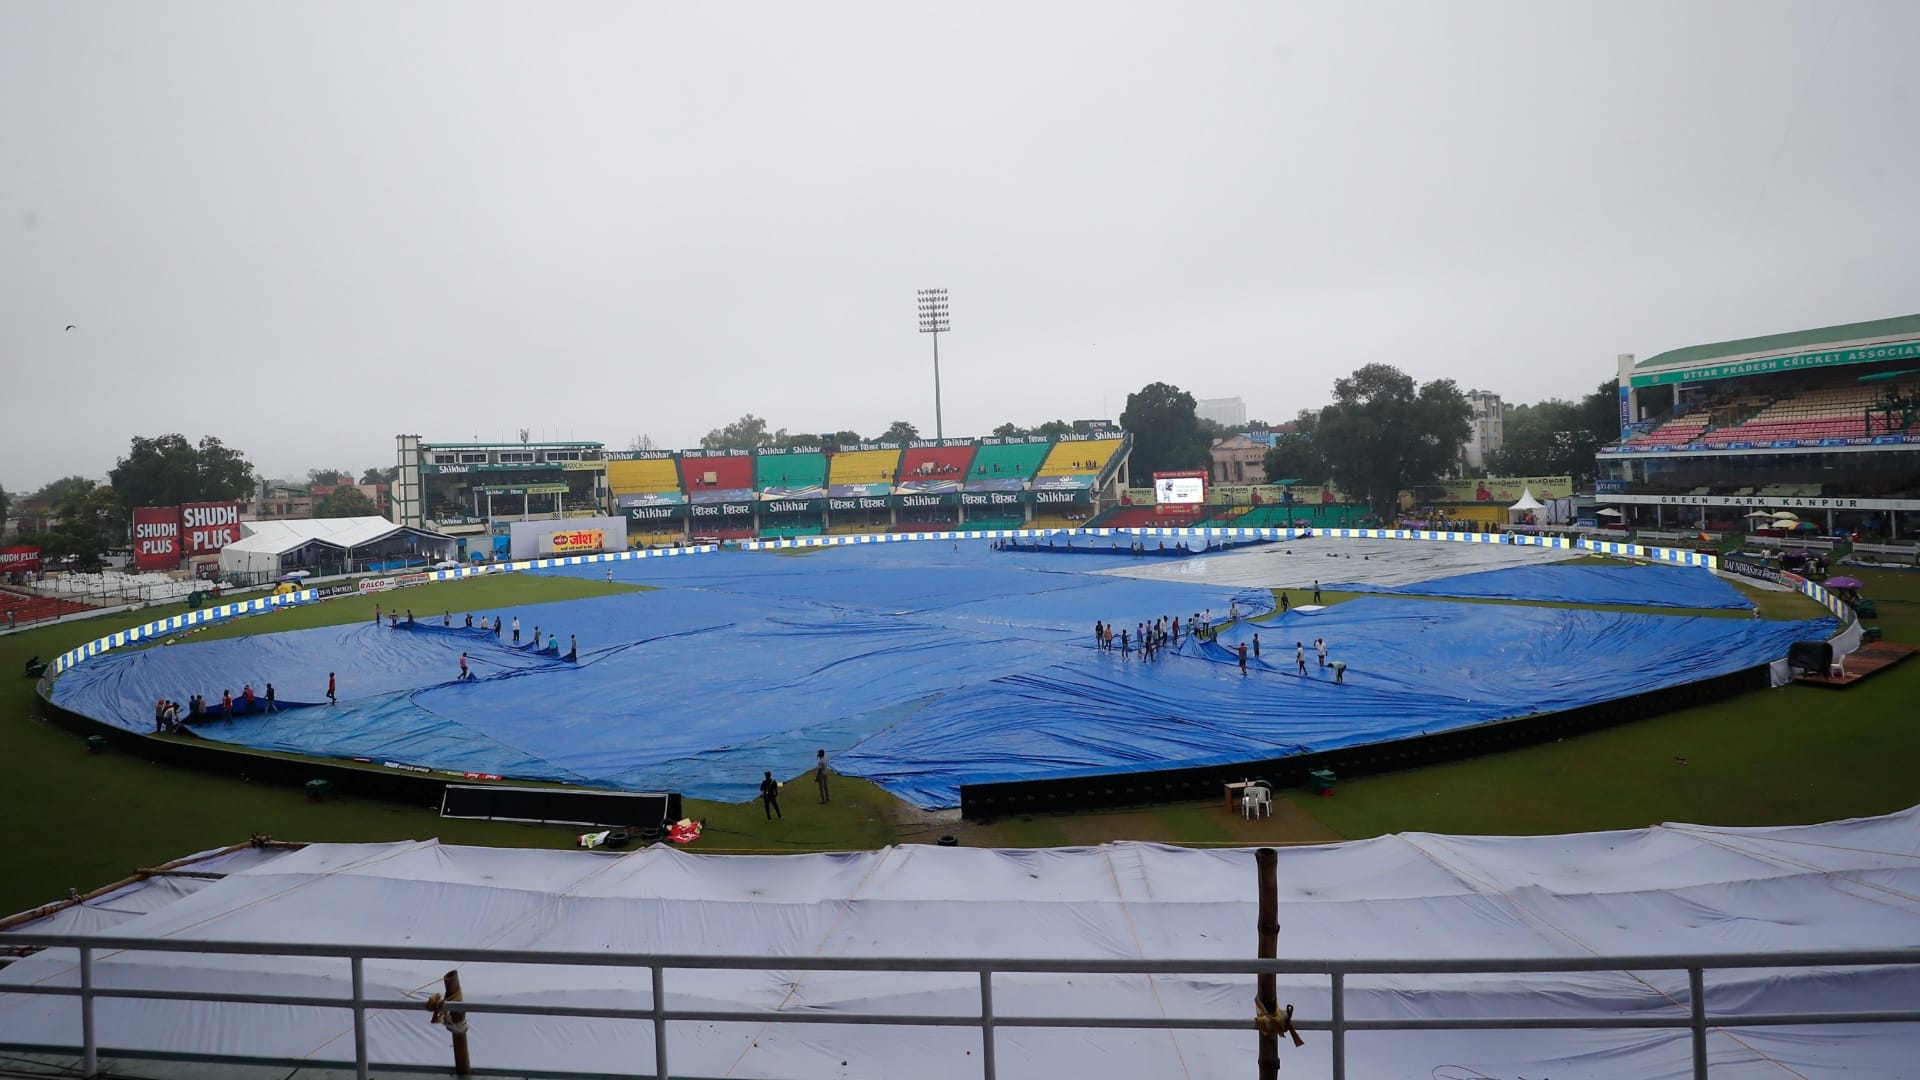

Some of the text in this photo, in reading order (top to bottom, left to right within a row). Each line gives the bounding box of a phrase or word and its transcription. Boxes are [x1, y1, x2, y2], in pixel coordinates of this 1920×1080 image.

[1683, 369, 1717, 379] UTTAR
[1723, 362, 1776, 374] PRADESH
[1784, 354, 1840, 367] CRICKET
[1060, 431, 1124, 442] Shikhar Shikhar
[909, 439, 971, 448] Shikhar Shikhar
[602, 451, 671, 460] Shikhar Shikhar
[793, 446, 821, 454] Shikhar
[439, 466, 469, 474] Shikhar
[903, 496, 940, 507] Shikhar
[962, 493, 1017, 504] शिखर शिखर
[1036, 492, 1074, 503] Shikhar
[1661, 496, 1857, 508] GREEN PARK KANPUR
[770, 502, 808, 512] Shikhar
[830, 498, 885, 510] शिखर शिखर
[632, 508, 672, 519] Shikhar
[691, 504, 750, 516] शिखर शिखर
[184, 505, 238, 528] SHUDH
[137, 523, 176, 538] SHUDH
[193, 529, 232, 551] PLUS
[569, 531, 592, 545] जोश
[143, 540, 172, 554] PLUS
[21, 552, 38, 561] PLUS
[360, 580, 384, 589] RALCO
